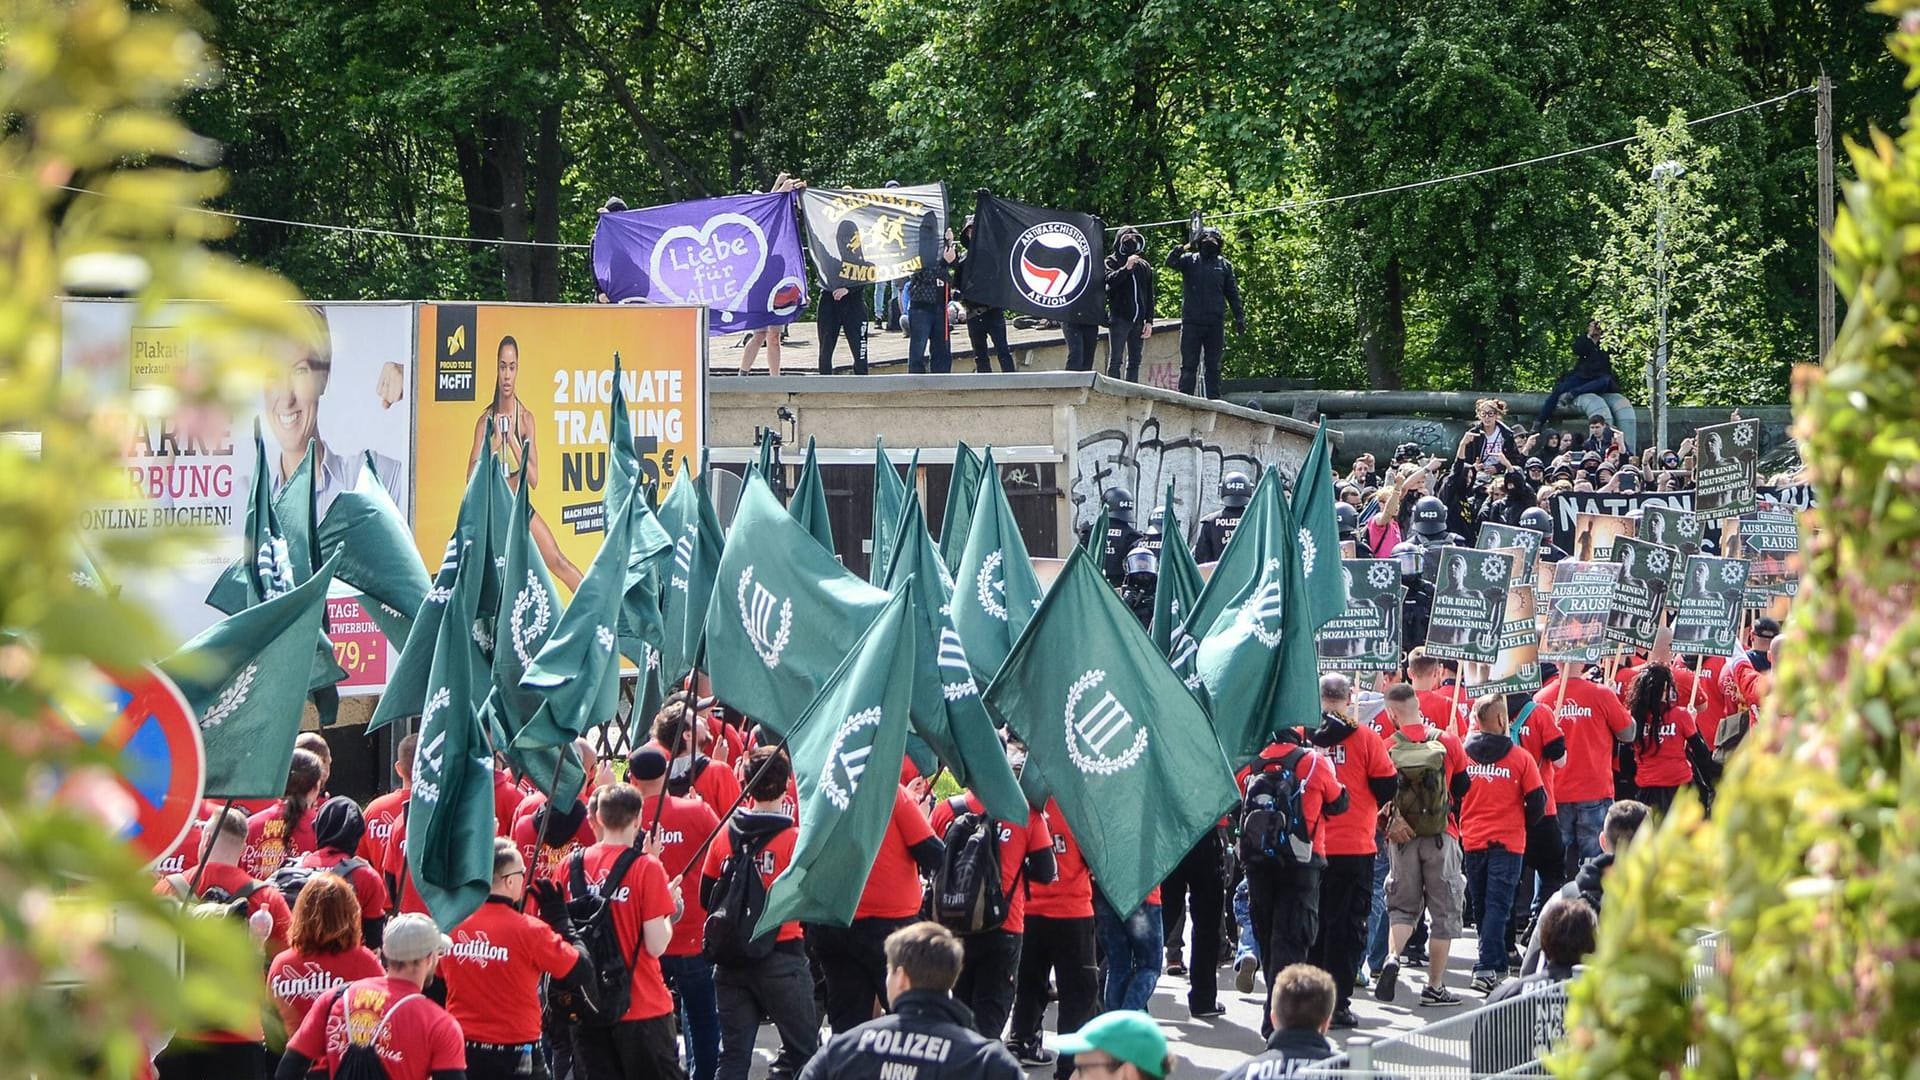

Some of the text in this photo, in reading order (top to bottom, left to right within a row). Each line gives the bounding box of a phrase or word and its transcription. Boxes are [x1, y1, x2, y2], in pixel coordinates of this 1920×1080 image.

[670, 232, 748, 271] Liebe
[685, 278, 739, 306] ALLE
[1027, 290, 1067, 305] AKTION
[440, 361, 457, 369] PROUD
[458, 361, 466, 369] TO
[439, 373, 472, 389] McFIT
[553, 368, 683, 404] 2 MONATE
[554, 408, 683, 444] TRAING
[128, 414, 234, 457] ARKE
[562, 452, 606, 492] NU
[1699, 463, 1738, 478] FÜR EINEN
[126, 464, 233, 499] RBUNG
[1698, 471, 1743, 487] DEUTSCHEN
[1698, 479, 1749, 496] SOZIALISMUS!
[80, 505, 232, 530] ONLINE BUCHEN!
[1713, 507, 1738, 518] DRITTE
[1739, 504, 1755, 513] WEG
[1215, 518, 1241, 527] POLIZE
[1741, 523, 1797, 534] AUSLÄNDER
[1762, 536, 1798, 549] RAUS!
[1552, 582, 1612, 596] AUSLÄNDER
[1621, 584, 1645, 596] EINEN
[1436, 594, 1482, 608] FÜR EINEN
[1571, 598, 1610, 611] RAUS!
[1612, 592, 1649, 607] UTSCHEN
[1681, 598, 1696, 608] FÜR
[1697, 599, 1720, 609] EINEN
[328, 603, 360, 618] TAGE
[1344, 608, 1374, 617] EINEN
[1434, 606, 1487, 619] DEUTSCHEN
[1611, 602, 1653, 619] ZIALISMUS!
[1679, 608, 1725, 619] DEUTSCHEN
[1323, 618, 1380, 629] DEUTSCHEN
[1432, 617, 1493, 631] SOZIALISMUS!
[1502, 619, 1536, 634] RBEIT
[1677, 618, 1730, 628] SOZIALISMUS!
[1321, 628, 1389, 640] SOZIALISMUS!
[1500, 633, 1537, 649] DELT!
[1635, 639, 1653, 649] WEG
[1684, 646, 1712, 654] DRITTE
[1714, 648, 1732, 656] WEG
[1426, 647, 1445, 656] DER
[1445, 649, 1475, 660] DRITTE
[1476, 653, 1496, 663] WEG
[1320, 662, 1397, 670] DER DRITTE WEG
[1468, 685, 1488, 698] DER
[1488, 683, 1519, 694] DRITTE
[1520, 680, 1540, 691] WEG
[443, 938, 509, 962] radition
[857, 1028, 952, 1063] POLIZEI
[880, 1060, 918, 1080] NRW
